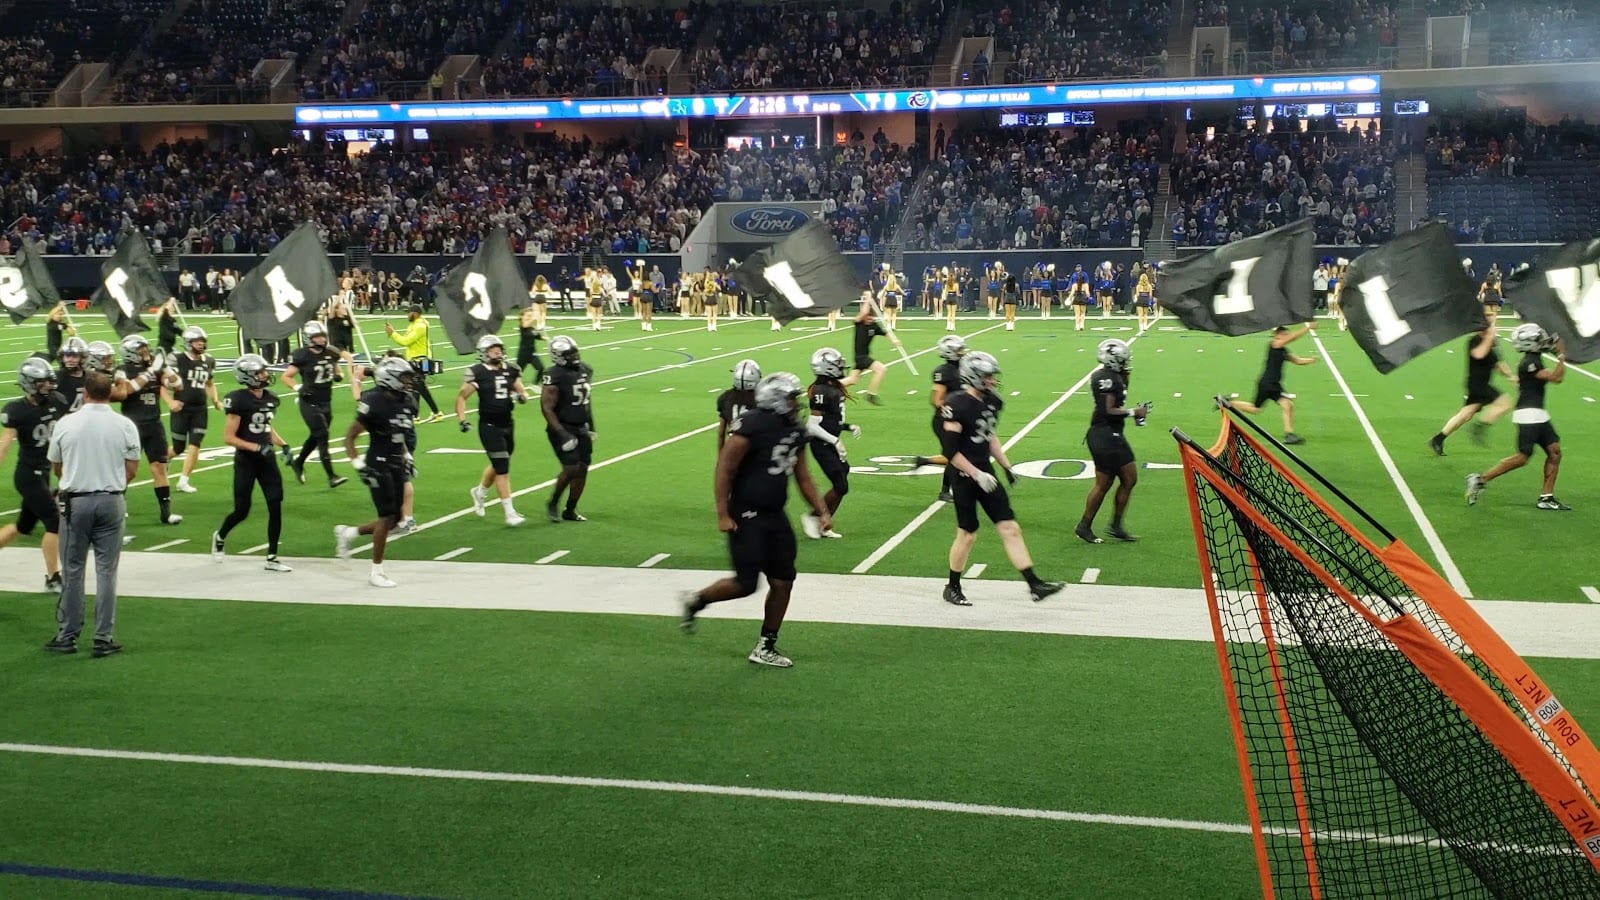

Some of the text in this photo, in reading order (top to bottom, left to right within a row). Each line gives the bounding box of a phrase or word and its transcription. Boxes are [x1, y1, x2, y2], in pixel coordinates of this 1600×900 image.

[749, 96, 786, 114] 2:26
[746, 209, 797, 231] Ford
[313, 363, 335, 384] 23
[495, 380, 509, 400] 5
[571, 382, 592, 406] 52
[813, 394, 824, 404] 31
[1515, 673, 1546, 704] NET
[1553, 717, 1580, 747] BOW
[1558, 799, 1600, 835] NET
